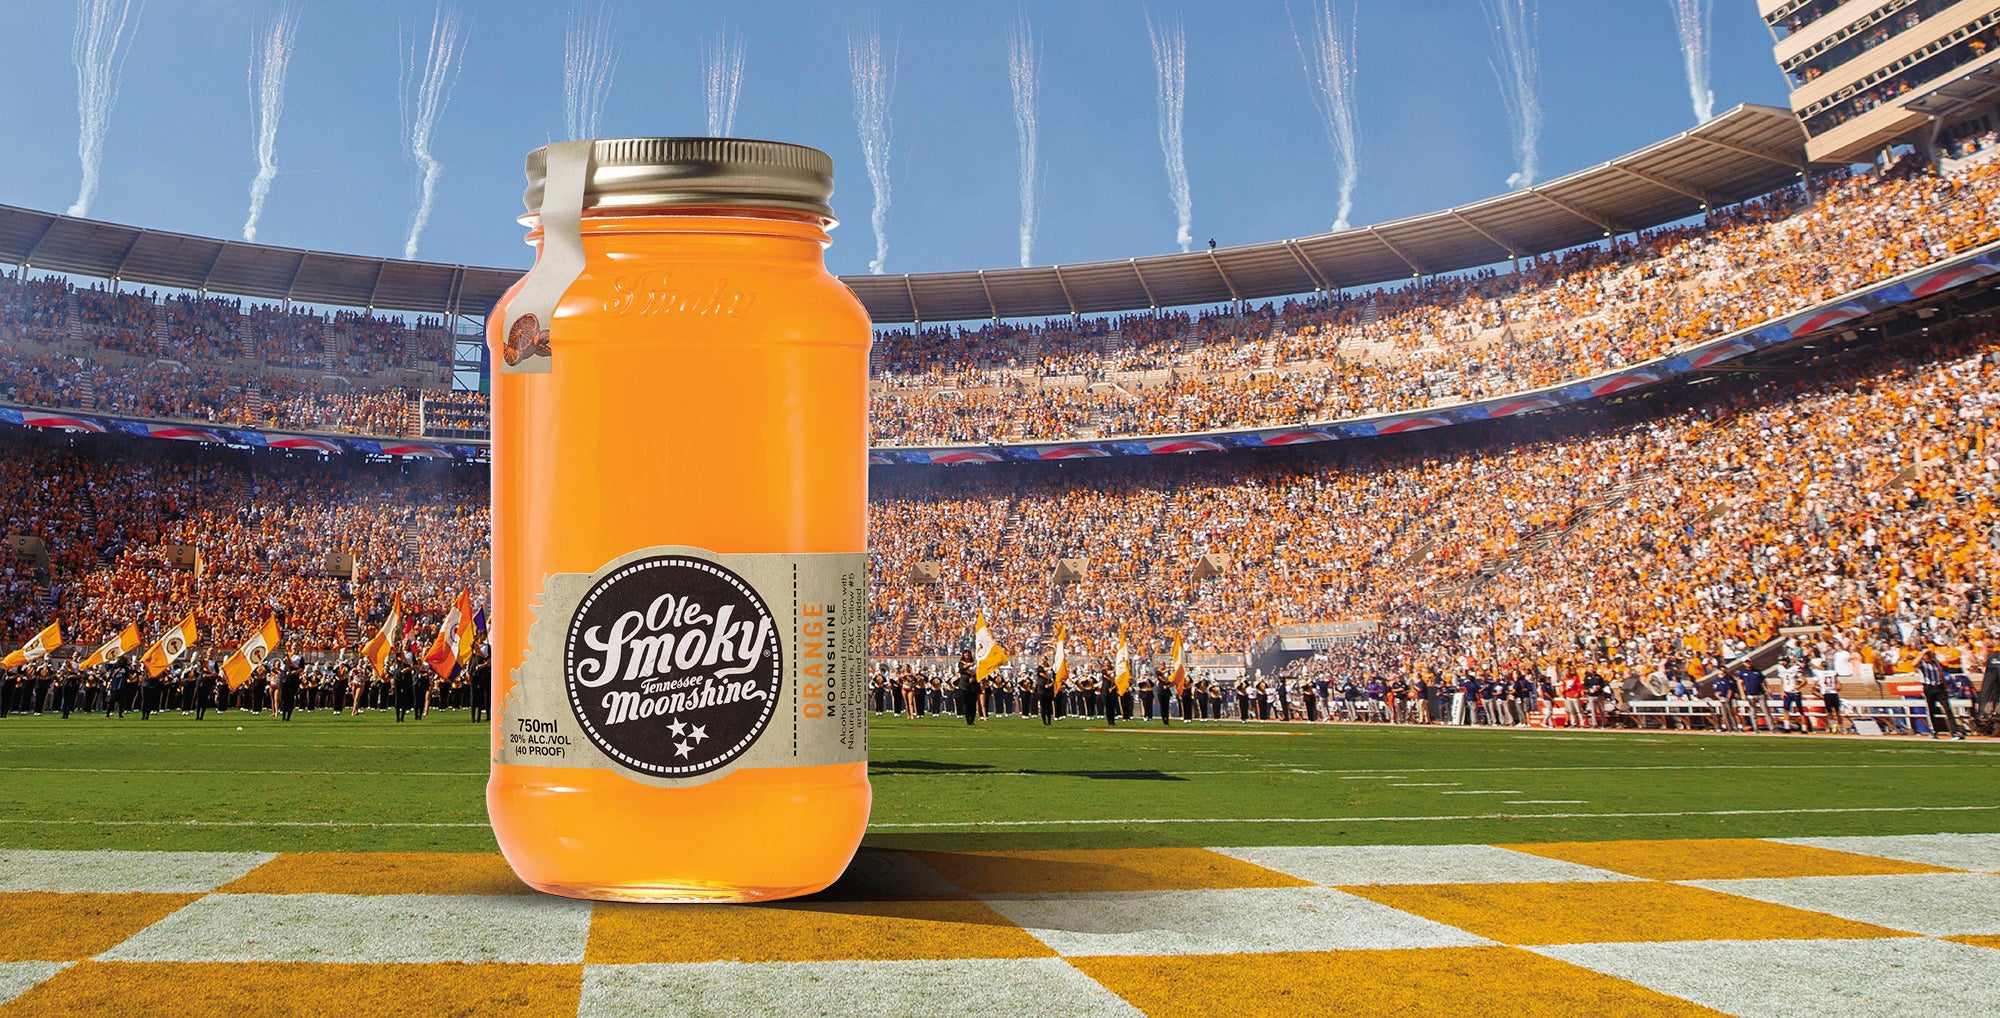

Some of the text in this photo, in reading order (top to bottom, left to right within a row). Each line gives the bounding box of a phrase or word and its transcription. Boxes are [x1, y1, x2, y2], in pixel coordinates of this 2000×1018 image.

[646, 593, 713, 631] Ole
[577, 605, 772, 687] Smoky
[803, 603, 824, 718] ORANGE
[827, 604, 836, 717] MOONSHINE
[601, 679, 767, 725] Moonshine
[641, 675, 703, 695] Tennessee
[510, 734, 571, 745] 20% ALC./VOL
[518, 719, 558, 733] 750ml
[515, 746, 565, 758] (40 PROOF)
